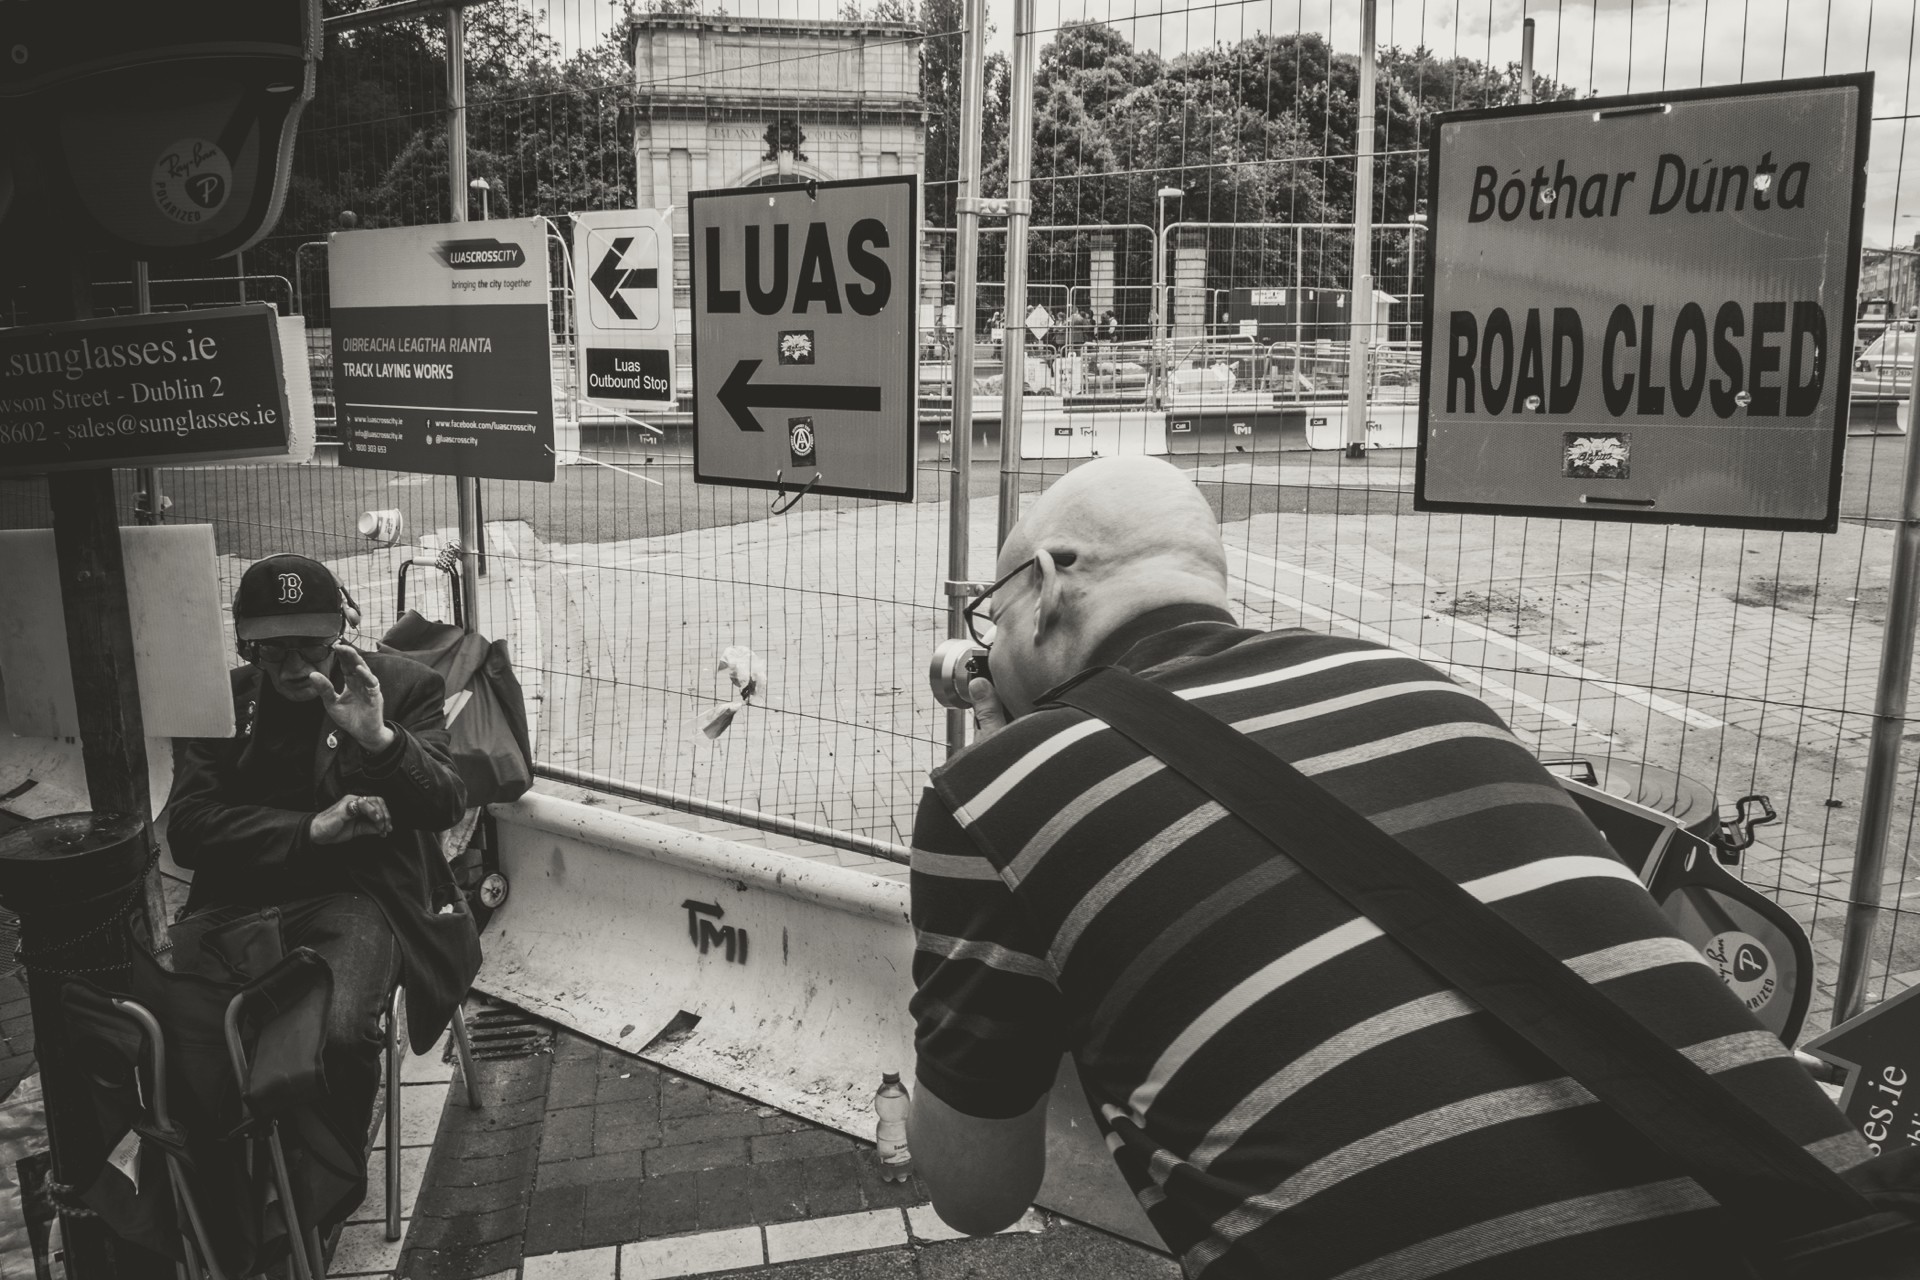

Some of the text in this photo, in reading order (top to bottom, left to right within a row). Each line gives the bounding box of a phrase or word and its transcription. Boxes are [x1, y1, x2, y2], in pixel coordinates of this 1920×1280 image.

[160, 142, 217, 179] Ray-Ban
[156, 182, 201, 221] POLARIZED
[1468, 150, 1811, 223] Bóthar Dúnta
[450, 249, 518, 264] LUASCROSSCITY
[705, 218, 892, 316] LUAS
[451, 278, 532, 292] bringing the city together
[5, 328, 218, 380] .sunglasses.ie
[343, 337, 492, 353] OIBREACHA LEAGTHA RIANTA
[1446, 300, 1828, 419] ROAD CLOSED
[343, 362, 454, 380] TRACK LAYING WORKS
[614, 357, 641, 373] Luas
[52, 388, 110, 410] Street
[131, 377, 204, 404] Dublin
[209, 376, 225, 398] 2
[589, 373, 668, 393] Outbound Stop
[0, 421, 48, 444] 8602
[67, 404, 277, 439] sales@sunglasses.ie
[435, 419, 537, 434] www.facebook.com/luascrosscity
[278, 572, 304, 604] B
[681, 899, 749, 967] TMI
